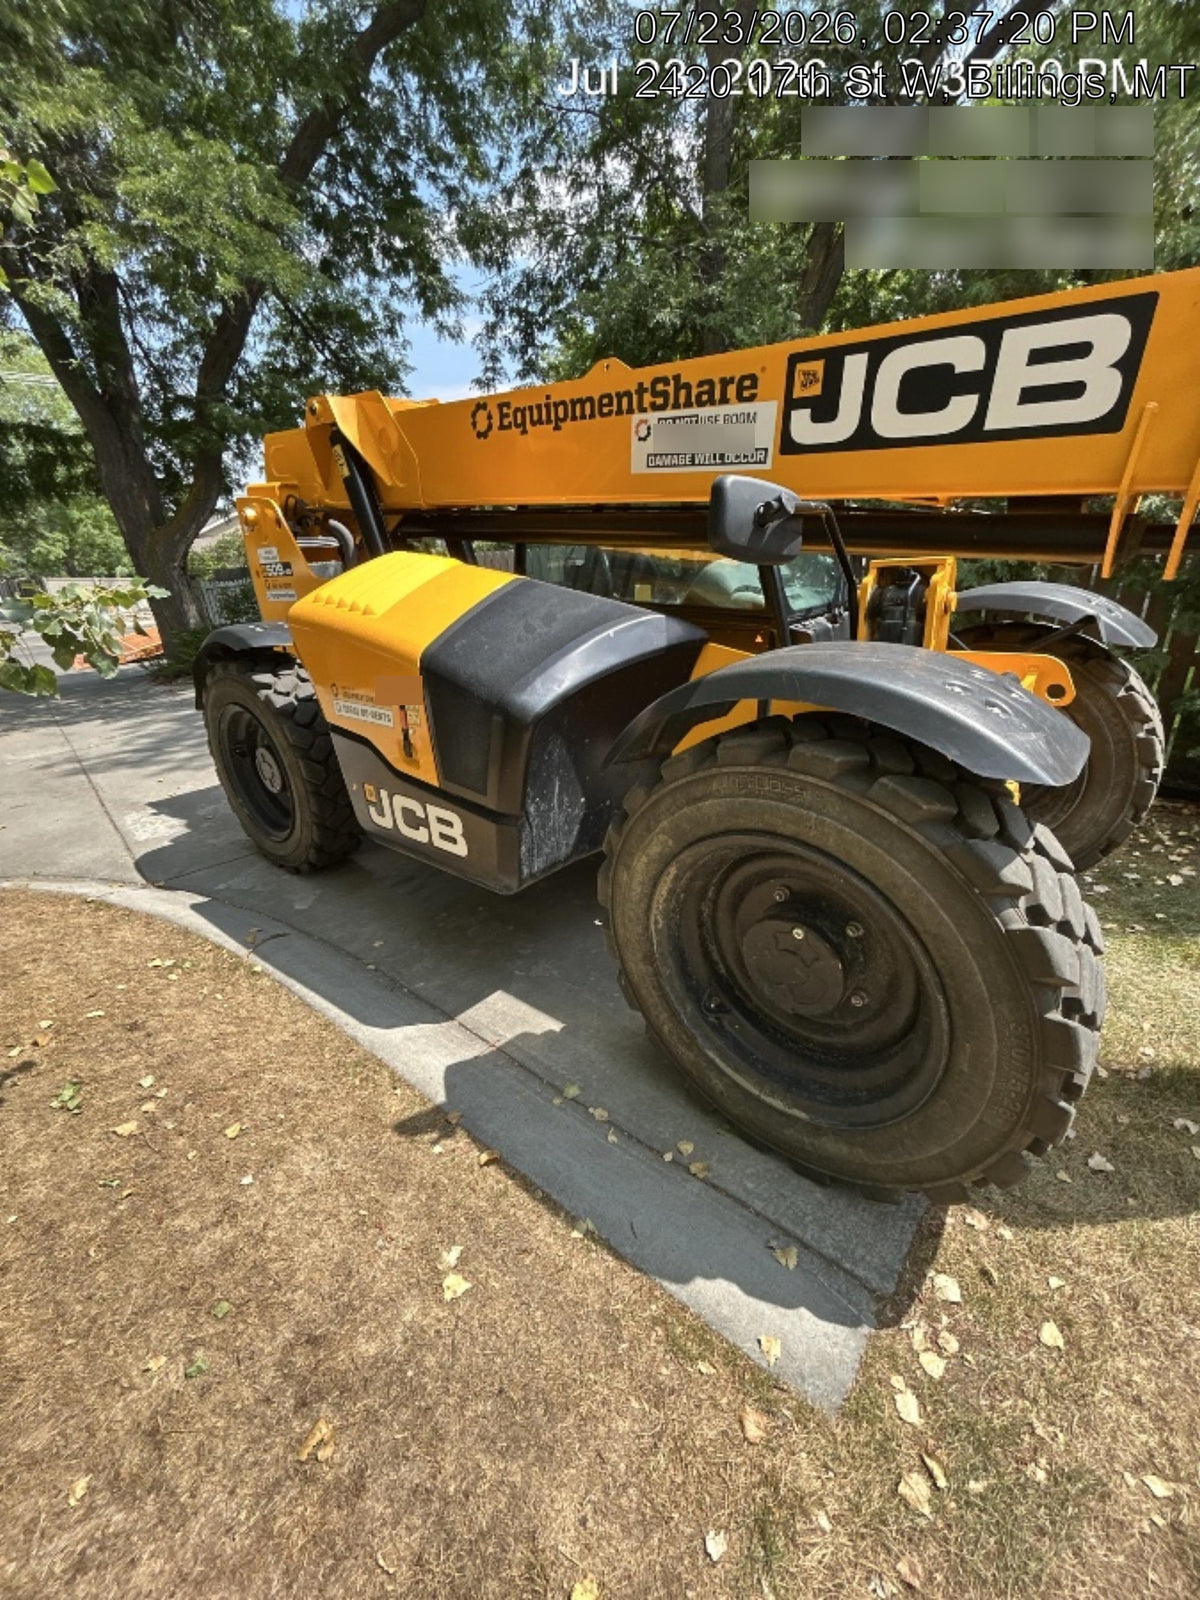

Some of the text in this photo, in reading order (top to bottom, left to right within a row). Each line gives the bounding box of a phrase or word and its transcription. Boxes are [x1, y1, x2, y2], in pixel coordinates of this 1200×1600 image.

[497, 373, 759, 435] EquipmentShare
[789, 313, 1132, 445] JCB
[723, 412, 757, 425] BOOM
[648, 449, 766, 467] DAMAGE WILL OCCUR
[368, 789, 468, 858] JCB
